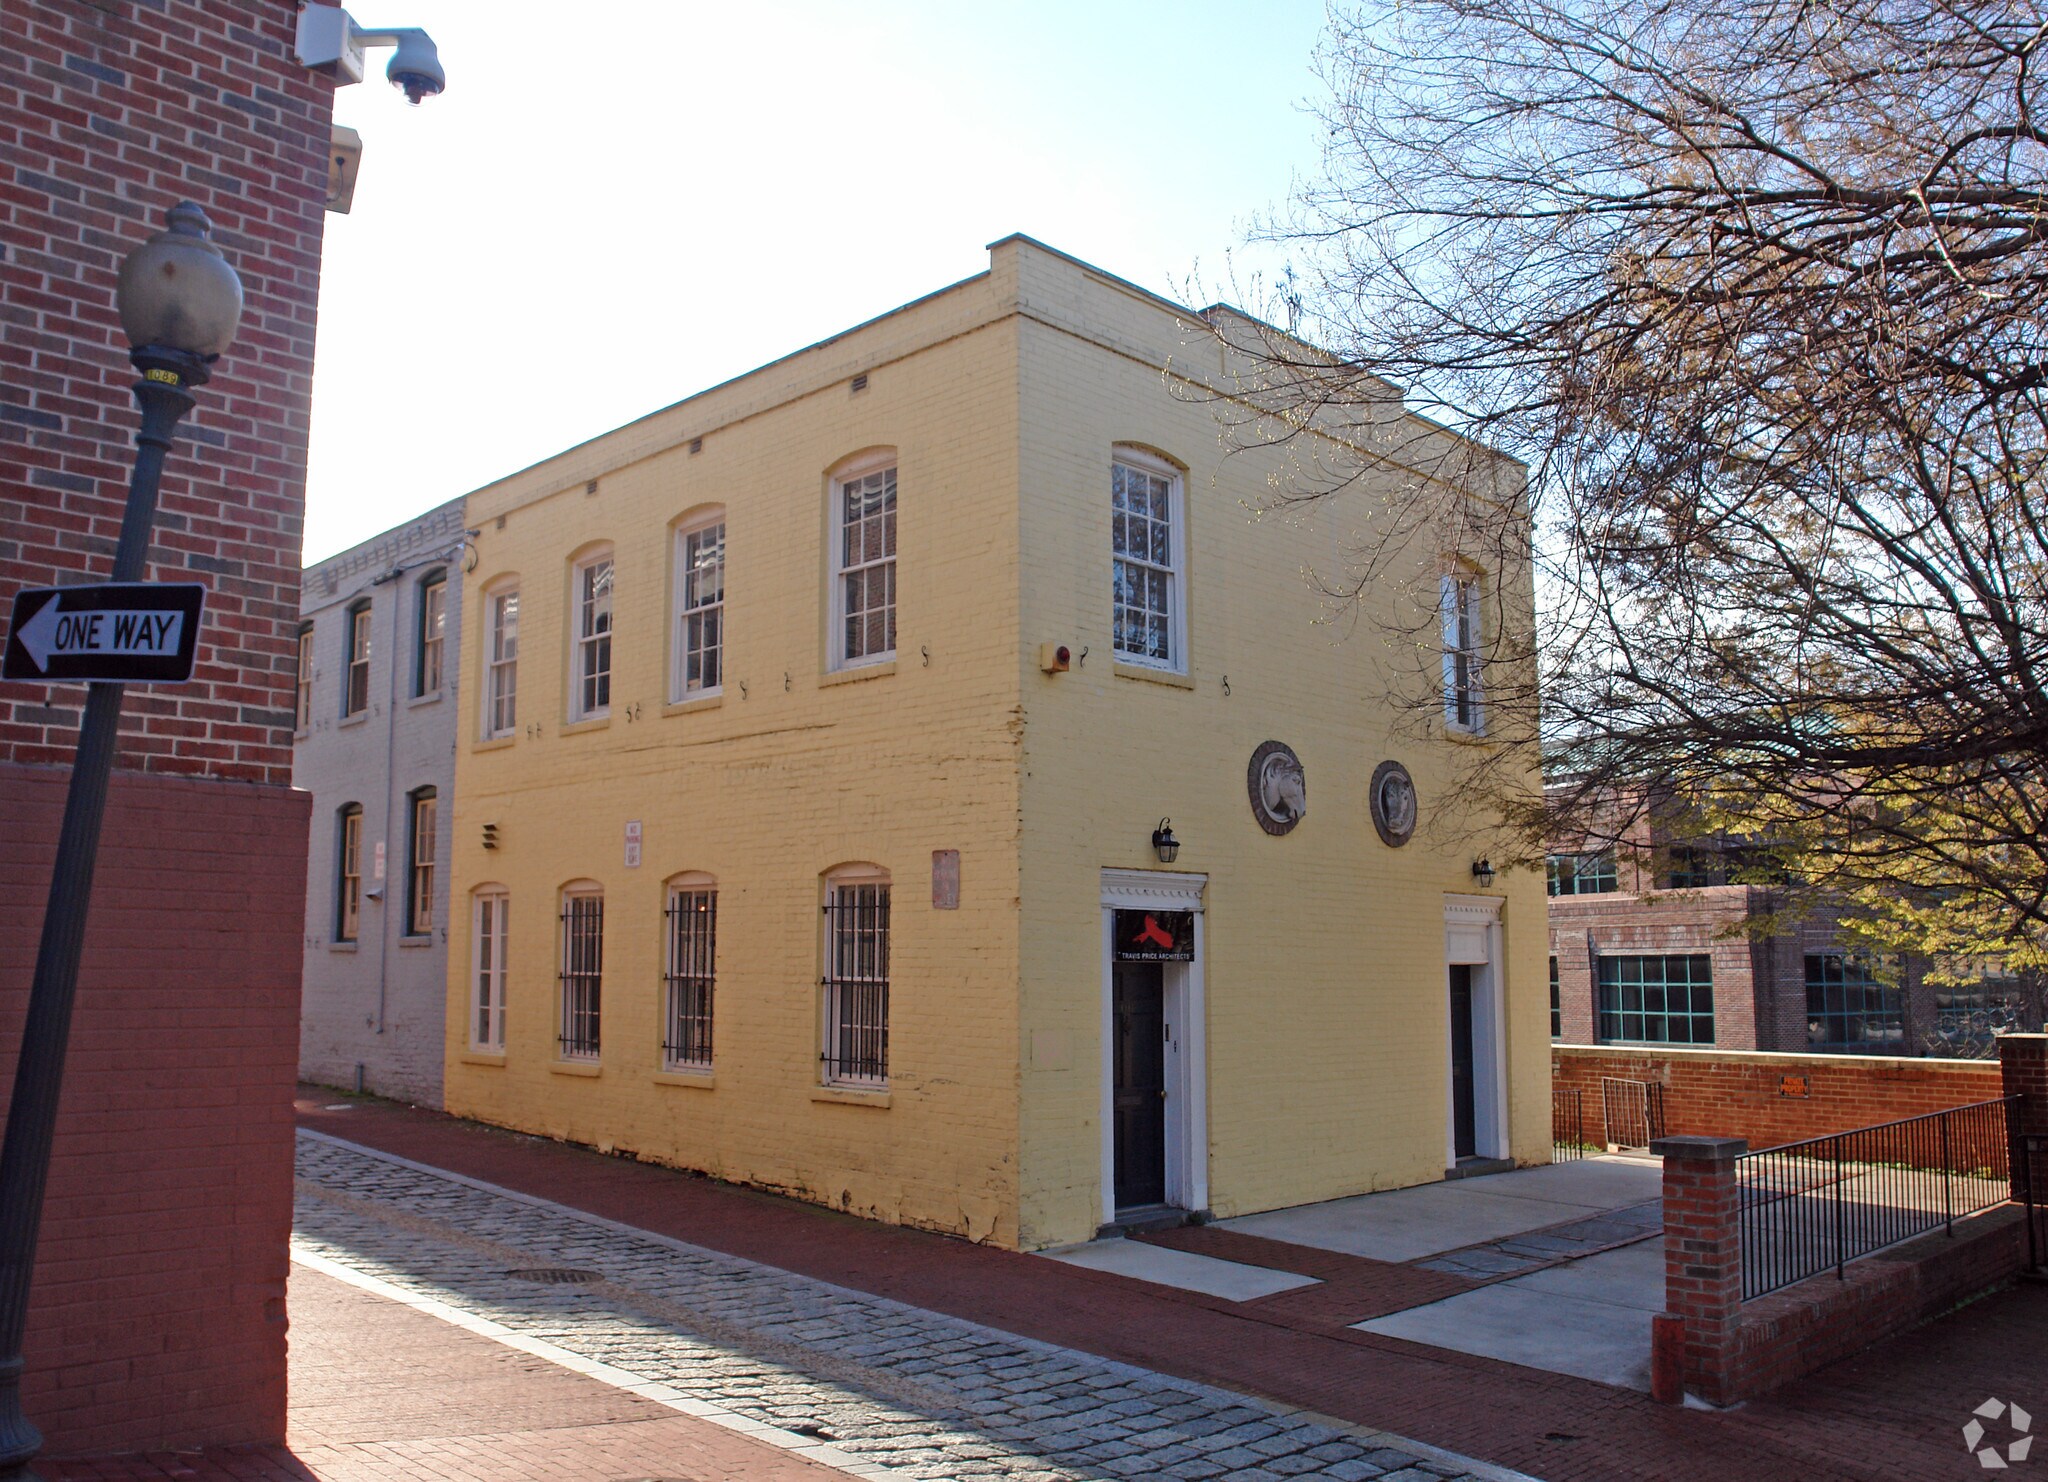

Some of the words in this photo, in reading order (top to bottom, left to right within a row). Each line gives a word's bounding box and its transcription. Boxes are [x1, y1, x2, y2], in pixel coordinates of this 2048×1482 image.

[149, 370, 177, 384] 1089
[55, 615, 104, 650] ONE
[113, 615, 175, 650] WAY
[1122, 952, 1140, 960] TRAVIS
[1142, 952, 1158, 960] PRICE
[1159, 952, 1190, 960] ARCHITECTS
